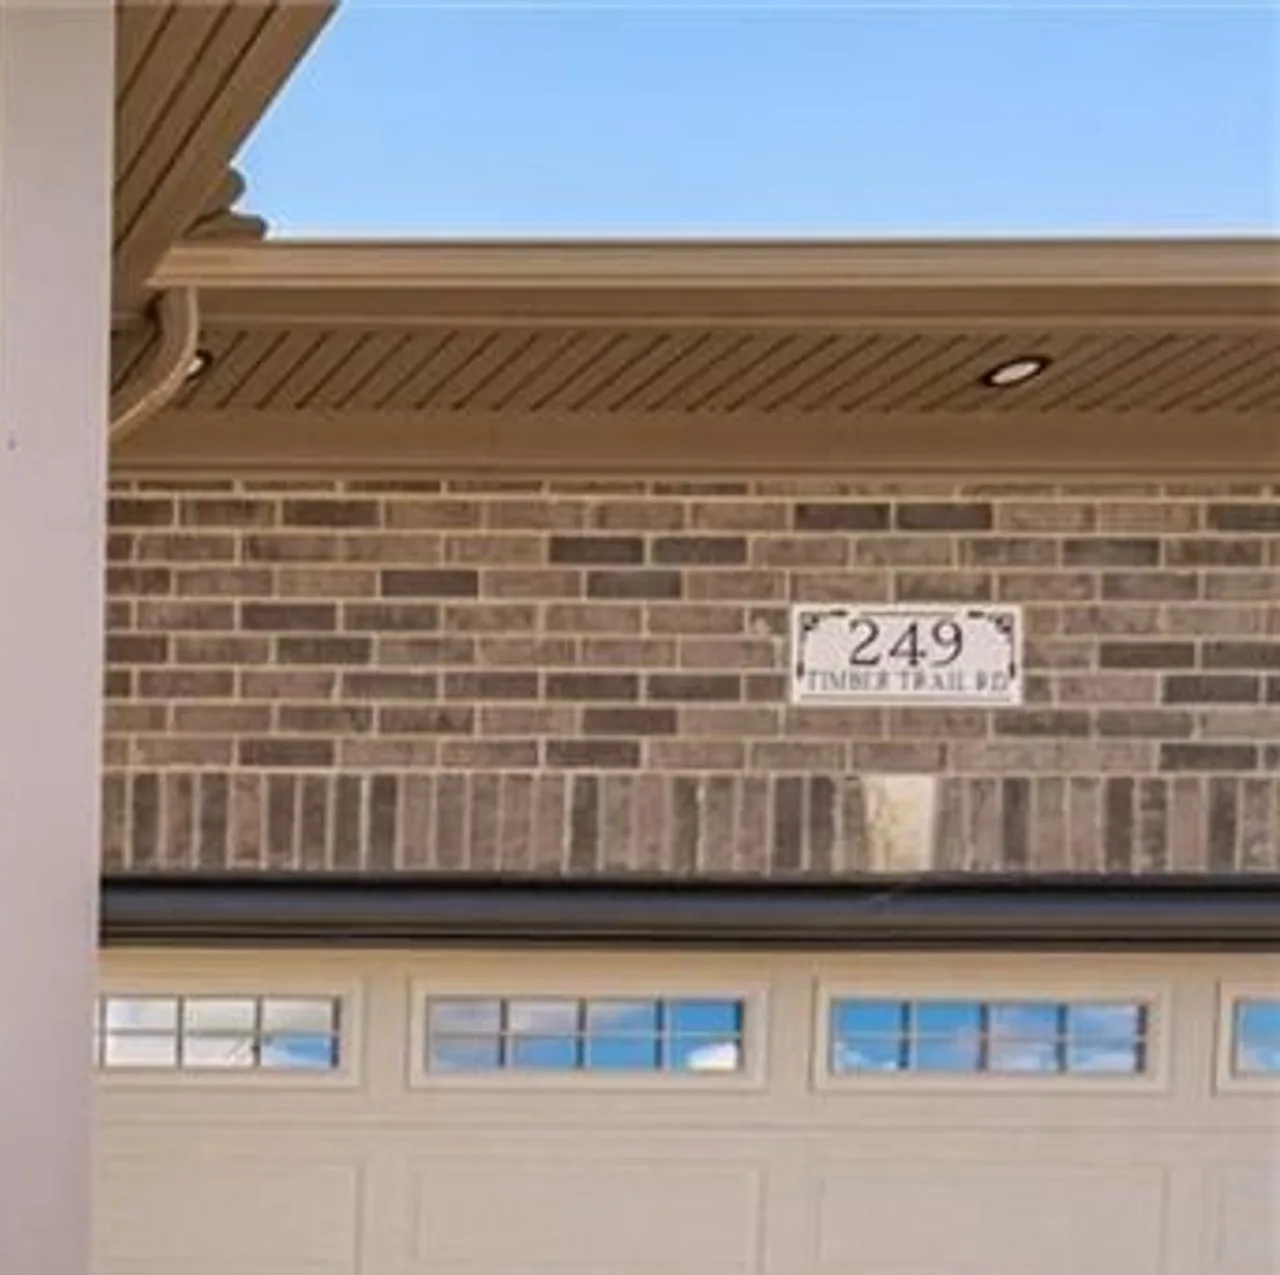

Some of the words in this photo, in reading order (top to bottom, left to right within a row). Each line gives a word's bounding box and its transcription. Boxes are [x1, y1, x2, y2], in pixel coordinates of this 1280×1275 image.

[848, 618, 963, 667] 249
[807, 671, 888, 692] TIMBER
[894, 671, 965, 692] TRAIL
